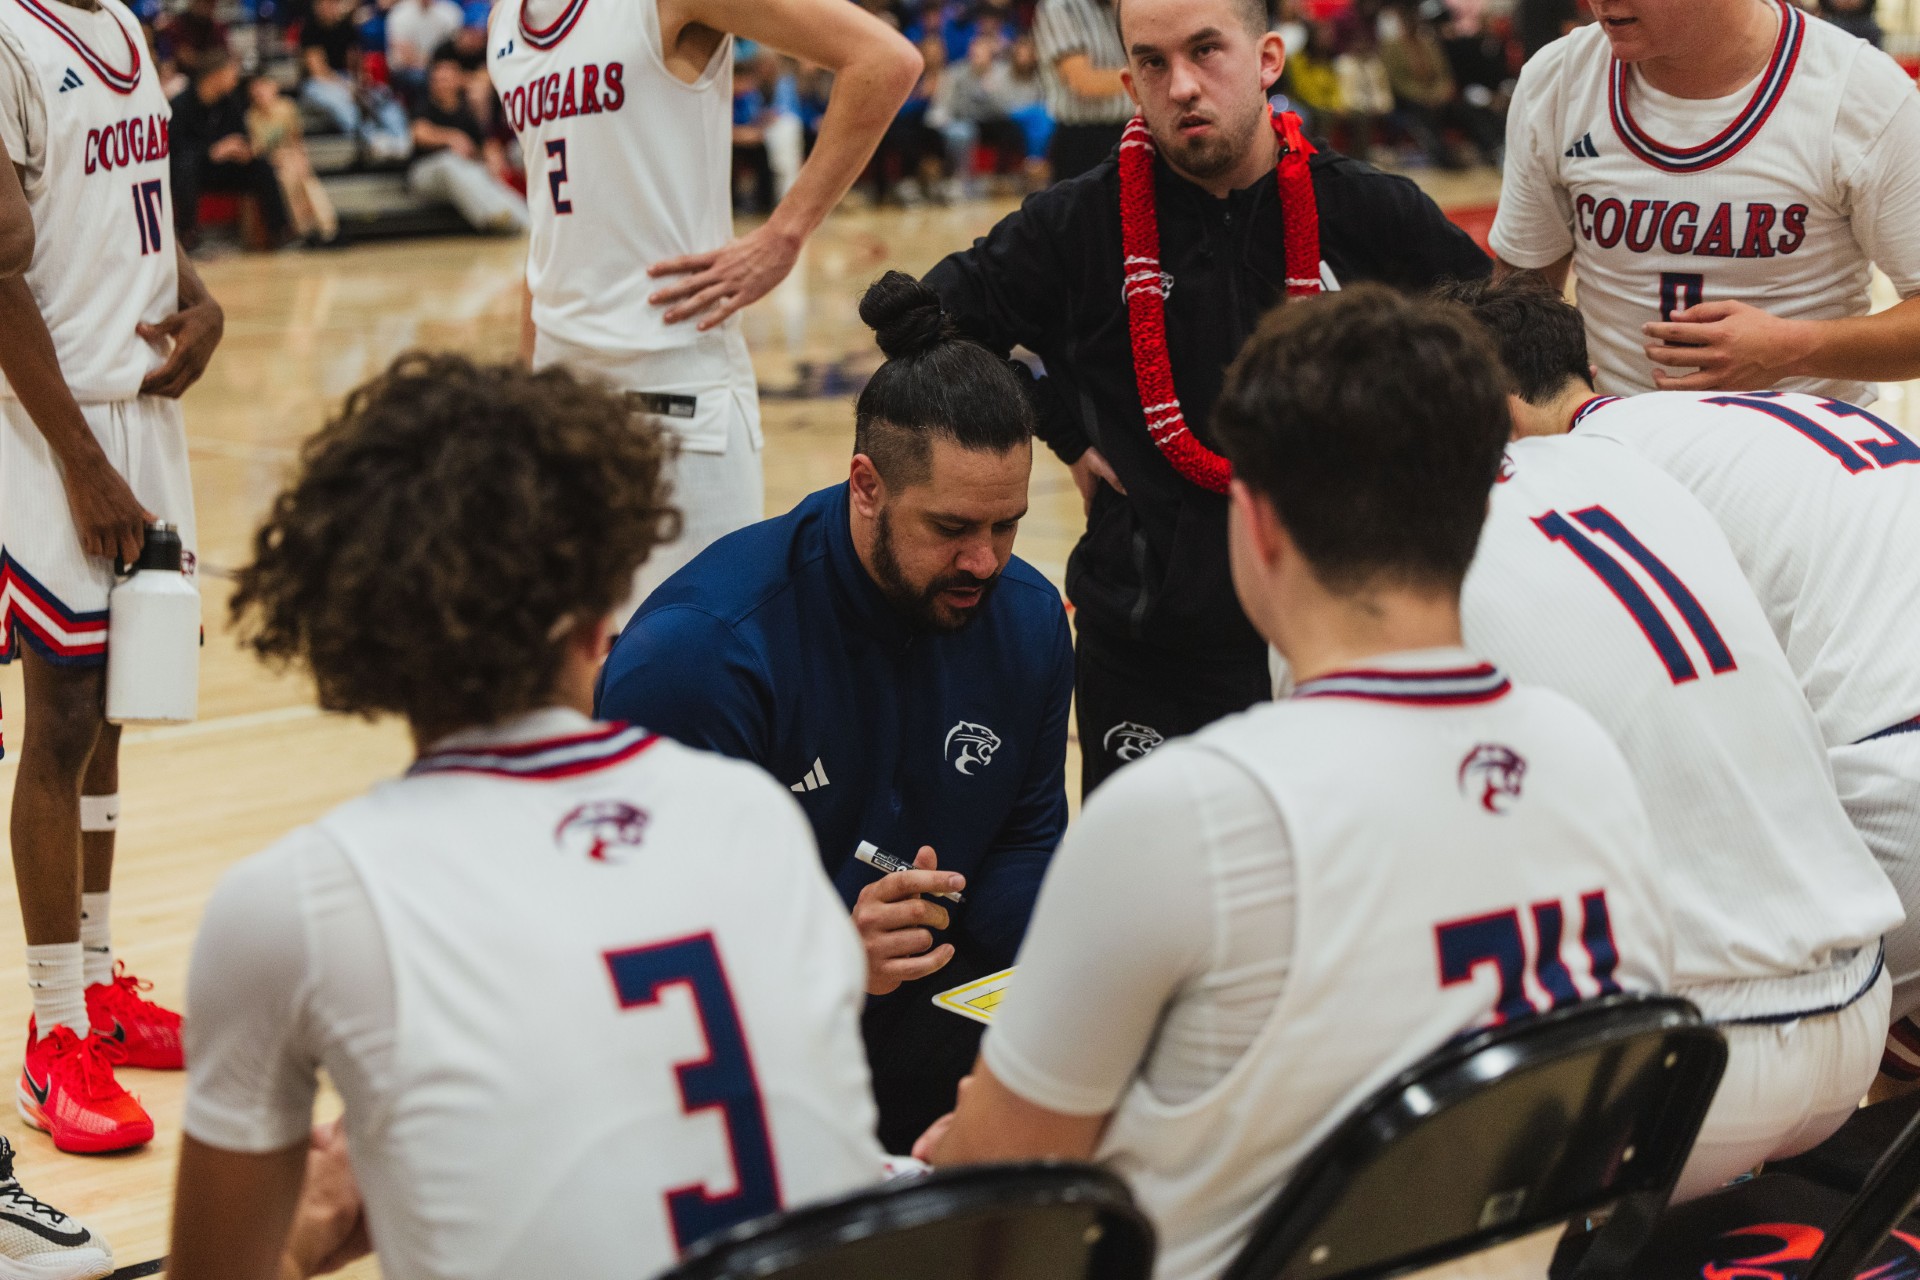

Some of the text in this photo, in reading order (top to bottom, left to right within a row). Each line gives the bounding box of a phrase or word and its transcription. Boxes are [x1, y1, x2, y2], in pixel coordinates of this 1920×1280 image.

[502, 62, 625, 132] COUGARS
[544, 138, 573, 215] 2
[131, 178, 163, 257] 10
[1576, 193, 1809, 258] COUGARS
[1698, 391, 1920, 475] 13
[1529, 504, 1738, 686] 11
[600, 929, 787, 1262] 3
